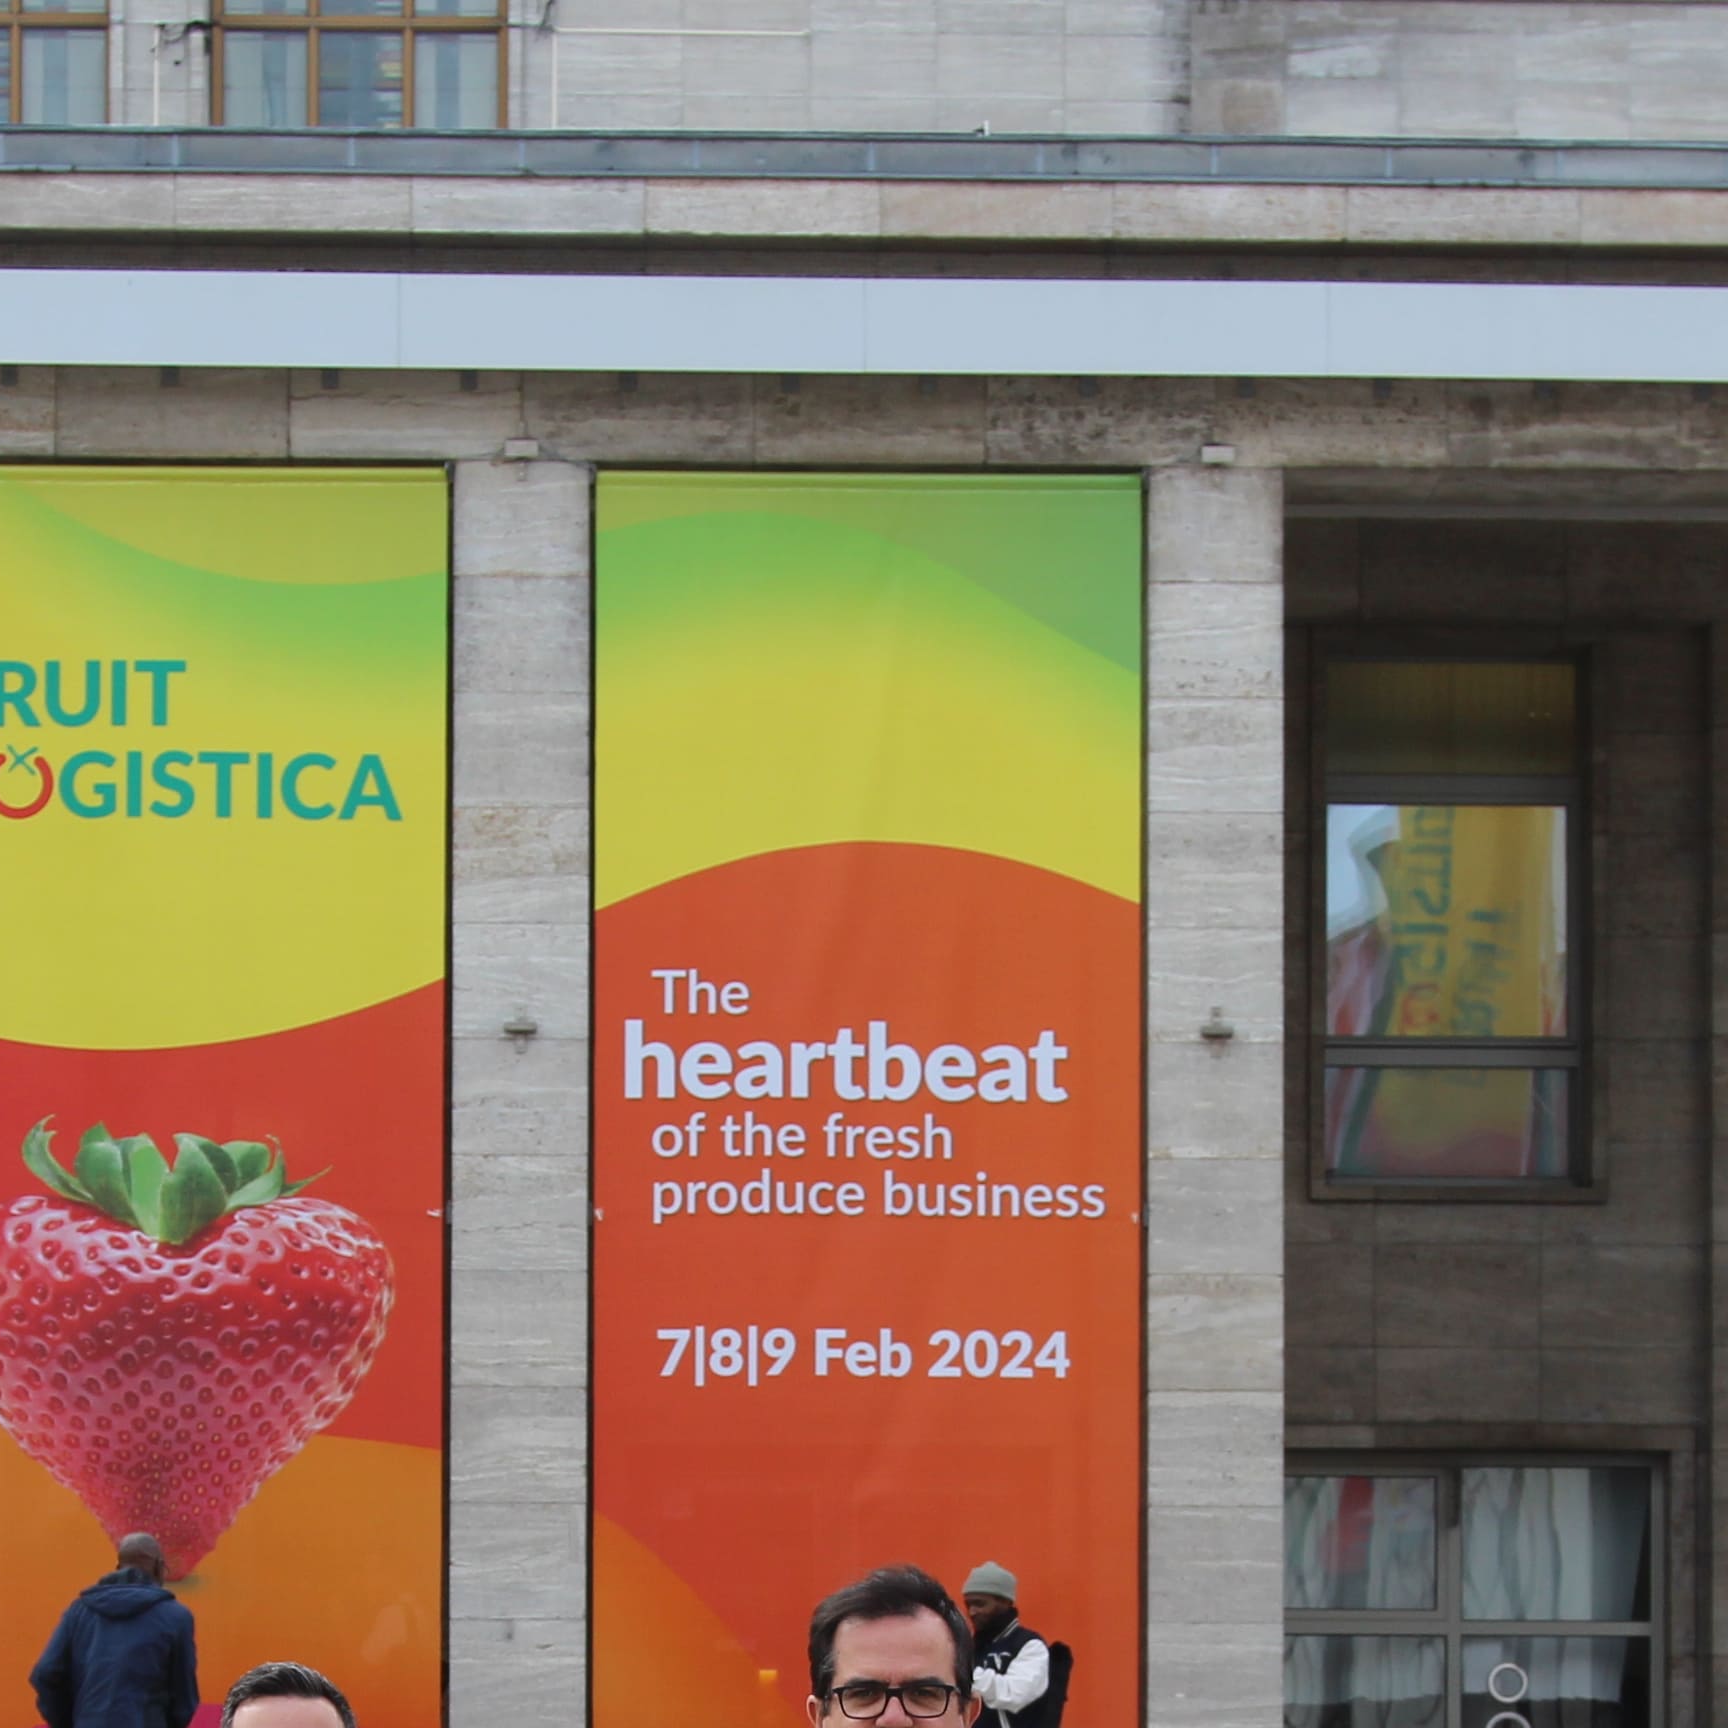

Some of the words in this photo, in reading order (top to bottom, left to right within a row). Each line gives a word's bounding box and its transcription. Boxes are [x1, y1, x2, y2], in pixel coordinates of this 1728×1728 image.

[651, 968, 750, 1015] The
[623, 1018, 1069, 1103] heartbeat
[651, 1111, 707, 1158] of
[719, 1110, 807, 1158] the
[822, 1112, 953, 1160] fresh
[652, 1167, 866, 1225] produce
[884, 1169, 1106, 1218] business
[814, 1327, 913, 1377] Feb
[927, 1329, 1071, 1379] 2024
